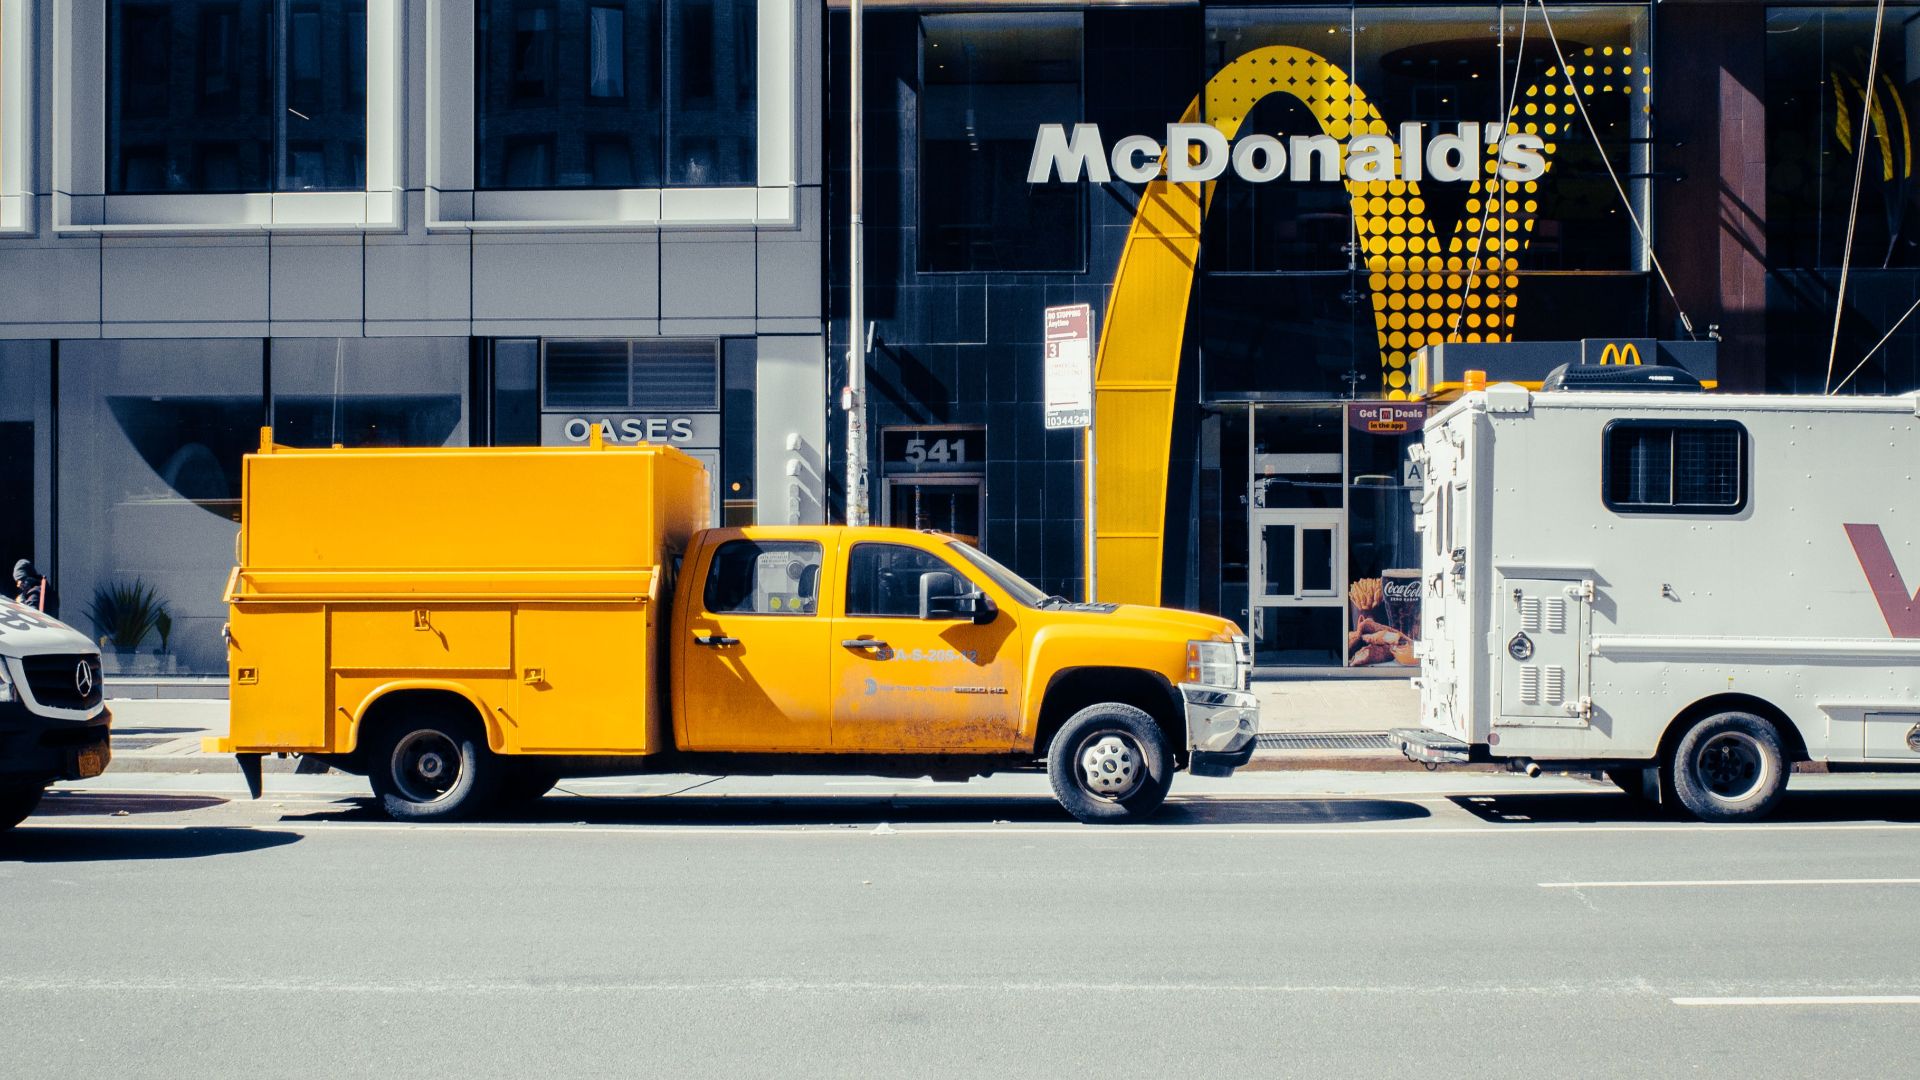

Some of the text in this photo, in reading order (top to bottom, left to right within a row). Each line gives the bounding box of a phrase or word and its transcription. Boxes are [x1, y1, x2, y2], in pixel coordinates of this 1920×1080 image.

[1026, 121, 1546, 183] McDonald's
[1049, 343, 1057, 358] 3
[1360, 409, 1377, 418] Get
[1395, 409, 1423, 418] Deals
[564, 418, 693, 442] OASES
[905, 438, 966, 465] 541
[1408, 464, 1421, 480] A
[1384, 581, 1422, 597] Coca-Col
